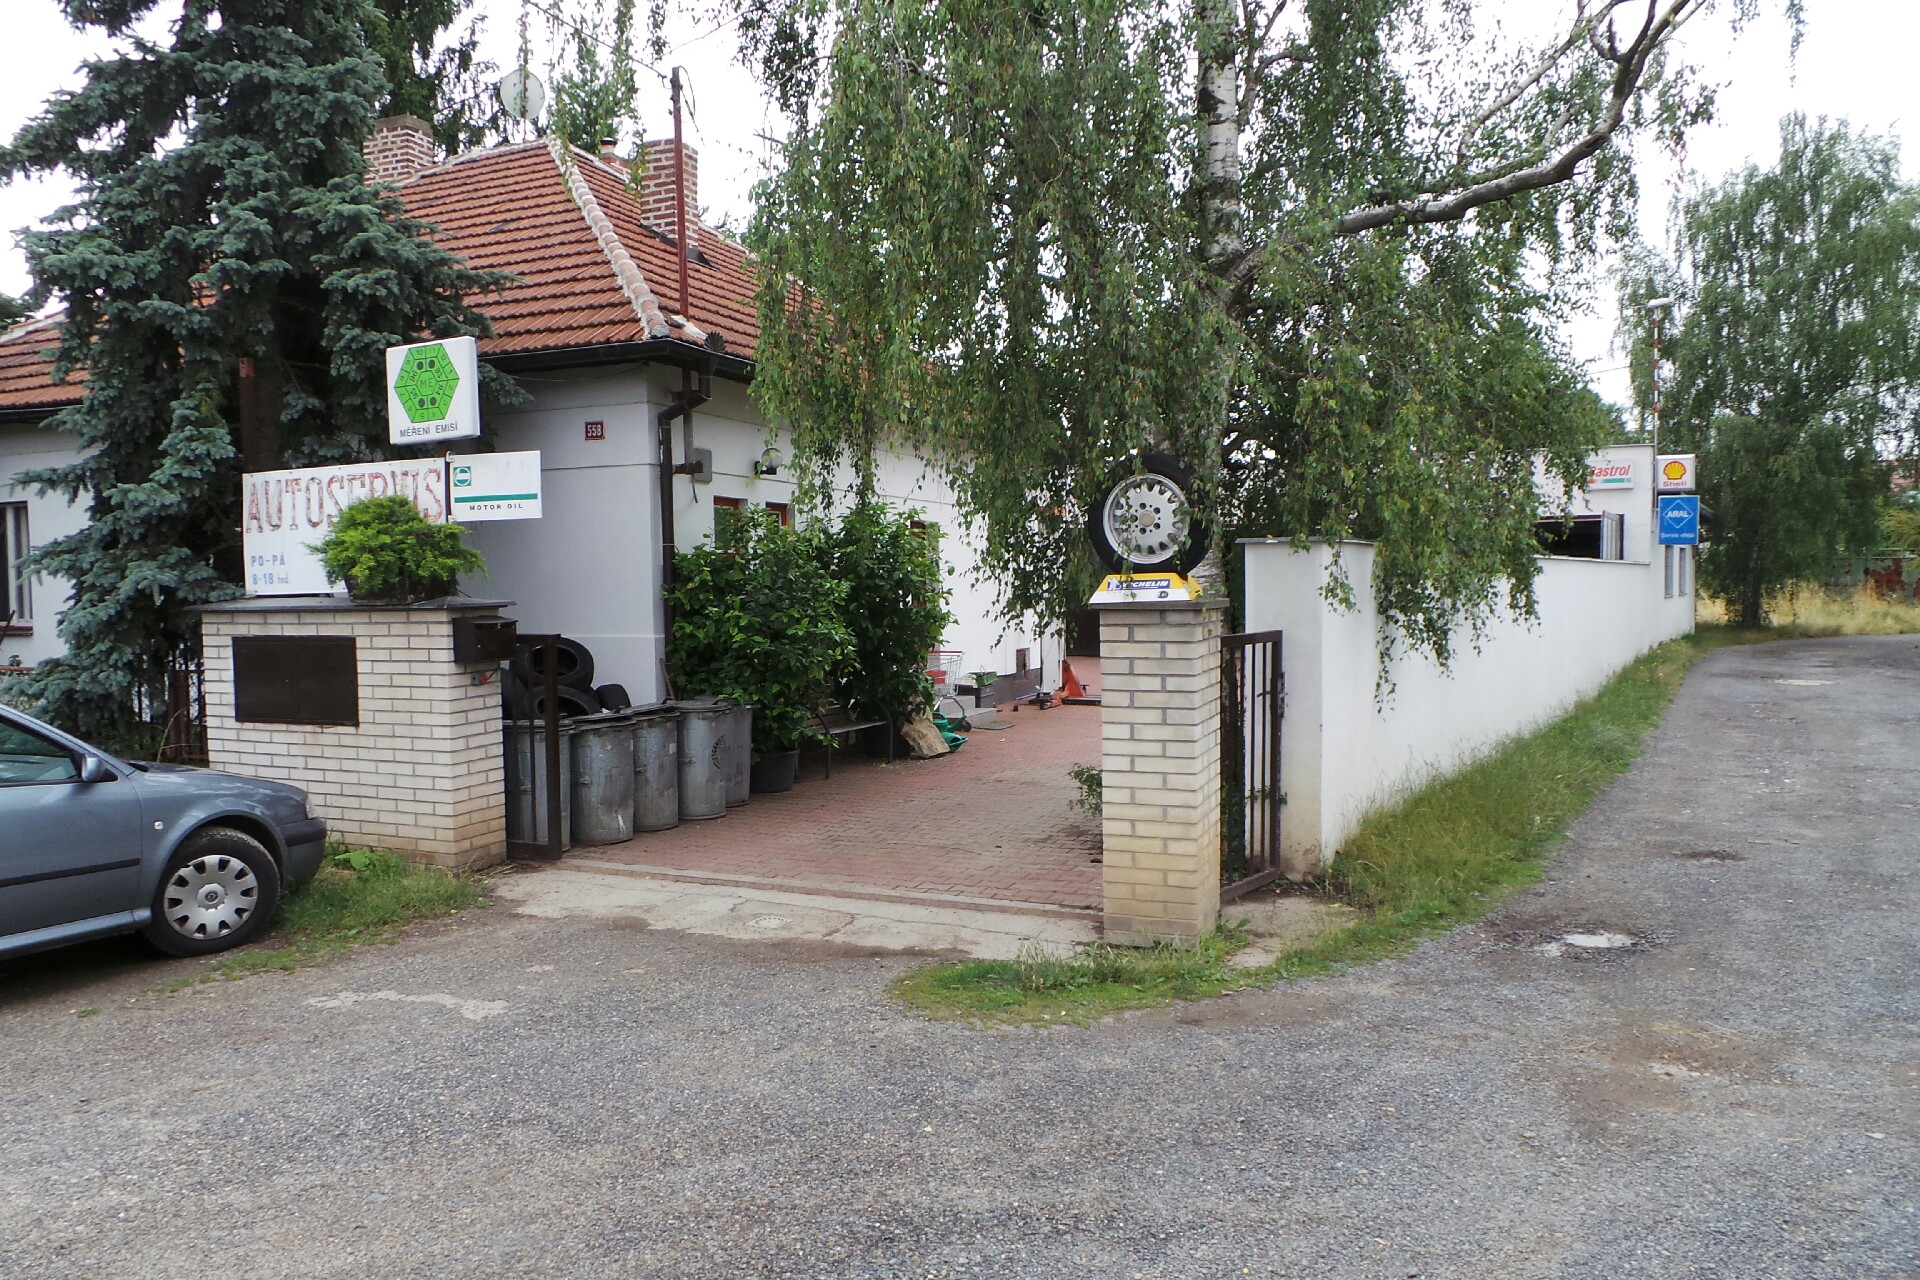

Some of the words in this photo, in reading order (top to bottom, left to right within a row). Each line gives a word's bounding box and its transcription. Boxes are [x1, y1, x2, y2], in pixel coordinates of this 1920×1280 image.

[420, 378, 433, 388] ME
[400, 424, 430, 437] MĚŘENÍ
[435, 420, 458, 433] EMISÍ
[587, 424, 601, 436] 558
[1667, 510, 1688, 518] ARAL
